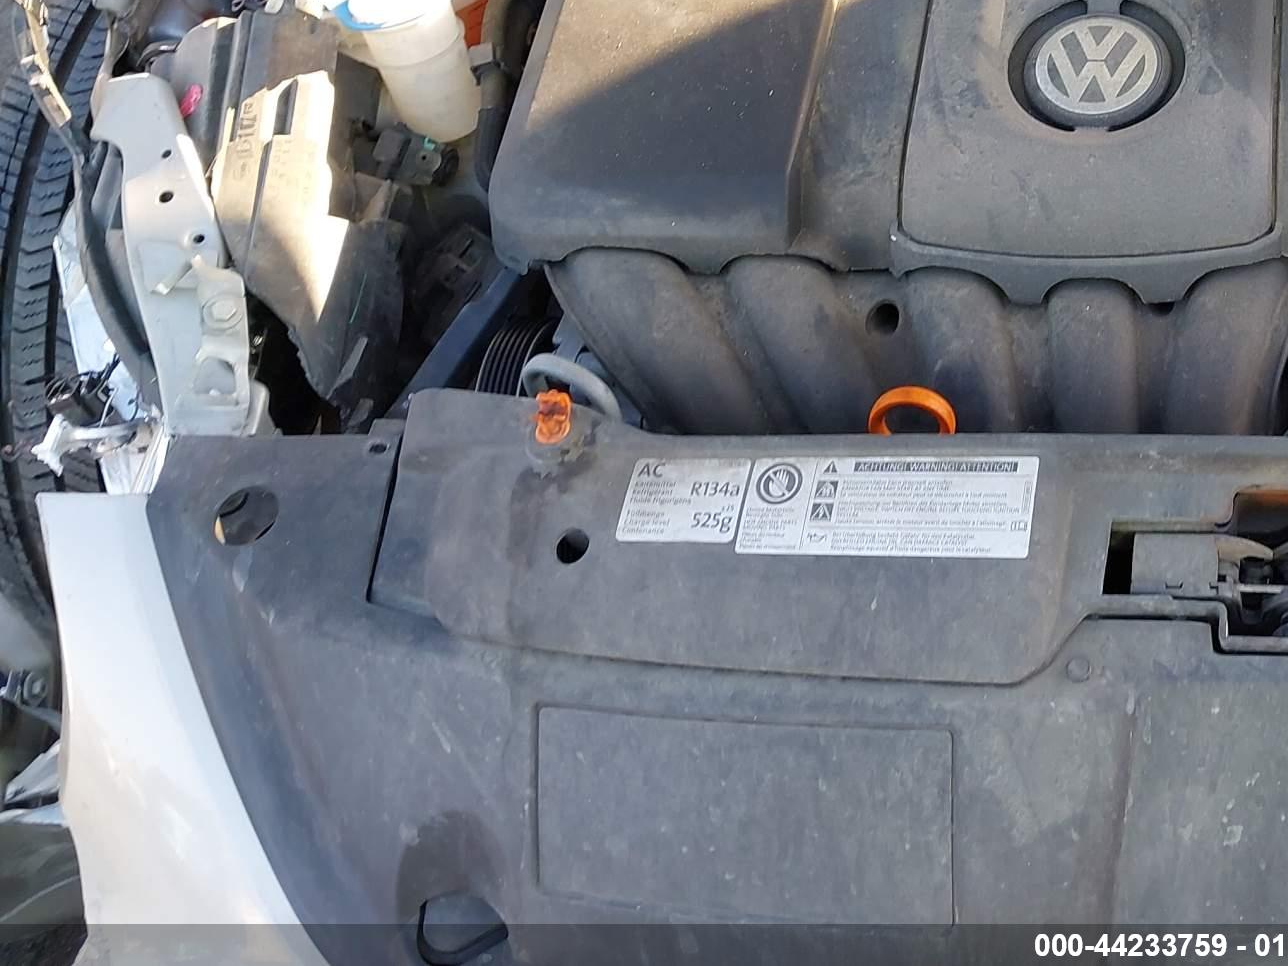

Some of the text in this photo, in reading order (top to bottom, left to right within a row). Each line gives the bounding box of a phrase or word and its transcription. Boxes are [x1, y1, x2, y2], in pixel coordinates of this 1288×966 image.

[637, 461, 666, 478] AC
[690, 481, 740, 497] R134a
[691, 512, 734, 534] 525g
